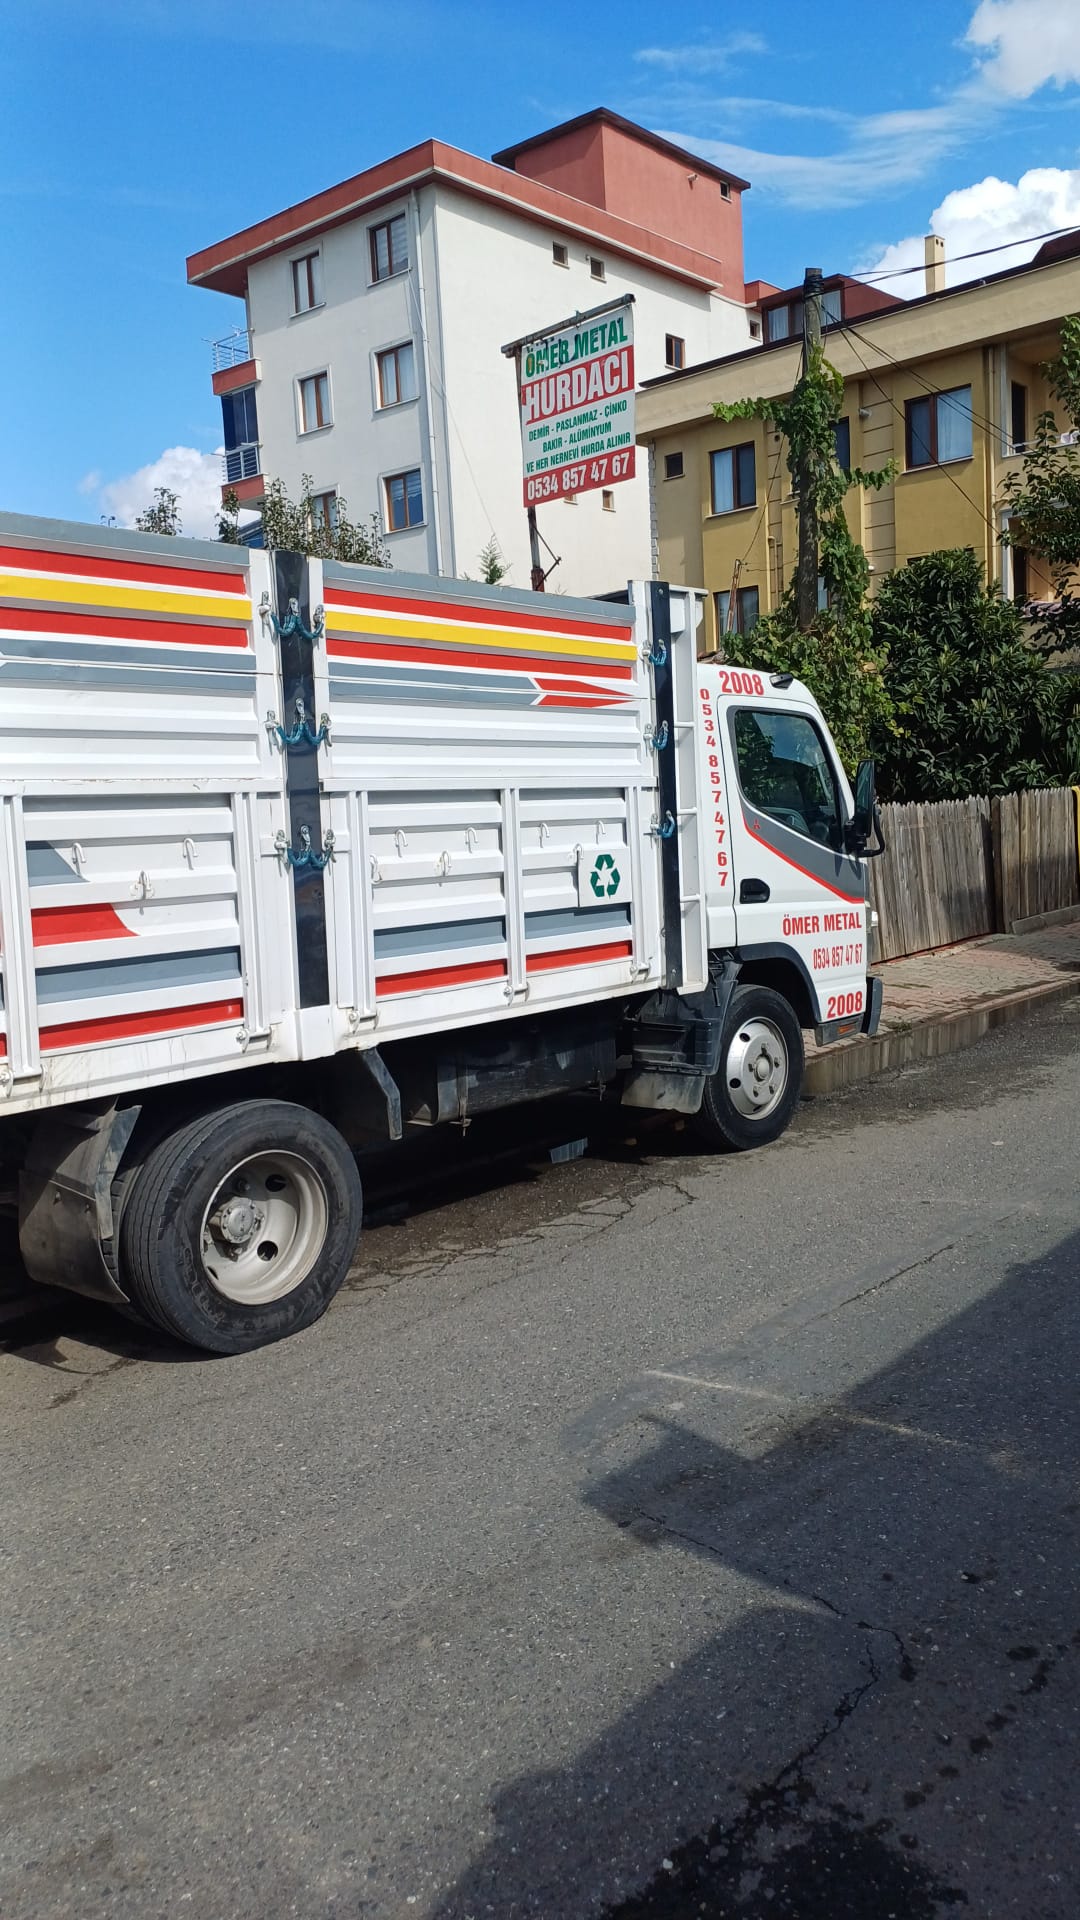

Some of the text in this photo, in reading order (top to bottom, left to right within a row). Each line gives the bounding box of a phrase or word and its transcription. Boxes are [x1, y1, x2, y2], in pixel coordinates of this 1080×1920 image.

[526, 317, 628, 377] ÖMER METAL
[525, 351, 629, 419] HURDACI
[529, 425, 550, 441] DEMİR
[556, 409, 598, 432] PASLANMAZ
[604, 400, 628, 418] ÇİNKO
[543, 437, 562, 452] BAKIR
[569, 421, 612, 444] ALÜMİNYUM
[526, 461, 534, 473] VE
[536, 457, 548, 470] HER
[581, 440, 605, 456] HURDA
[607, 432, 631, 450] ALINIR
[527, 452, 630, 500] 0534 857 47 67
[719, 670, 765, 696] 2008
[783, 912, 862, 936] ÖMER METAL
[813, 943, 863, 970] 0534 857 47 67
[826, 990, 863, 1018] 2008
